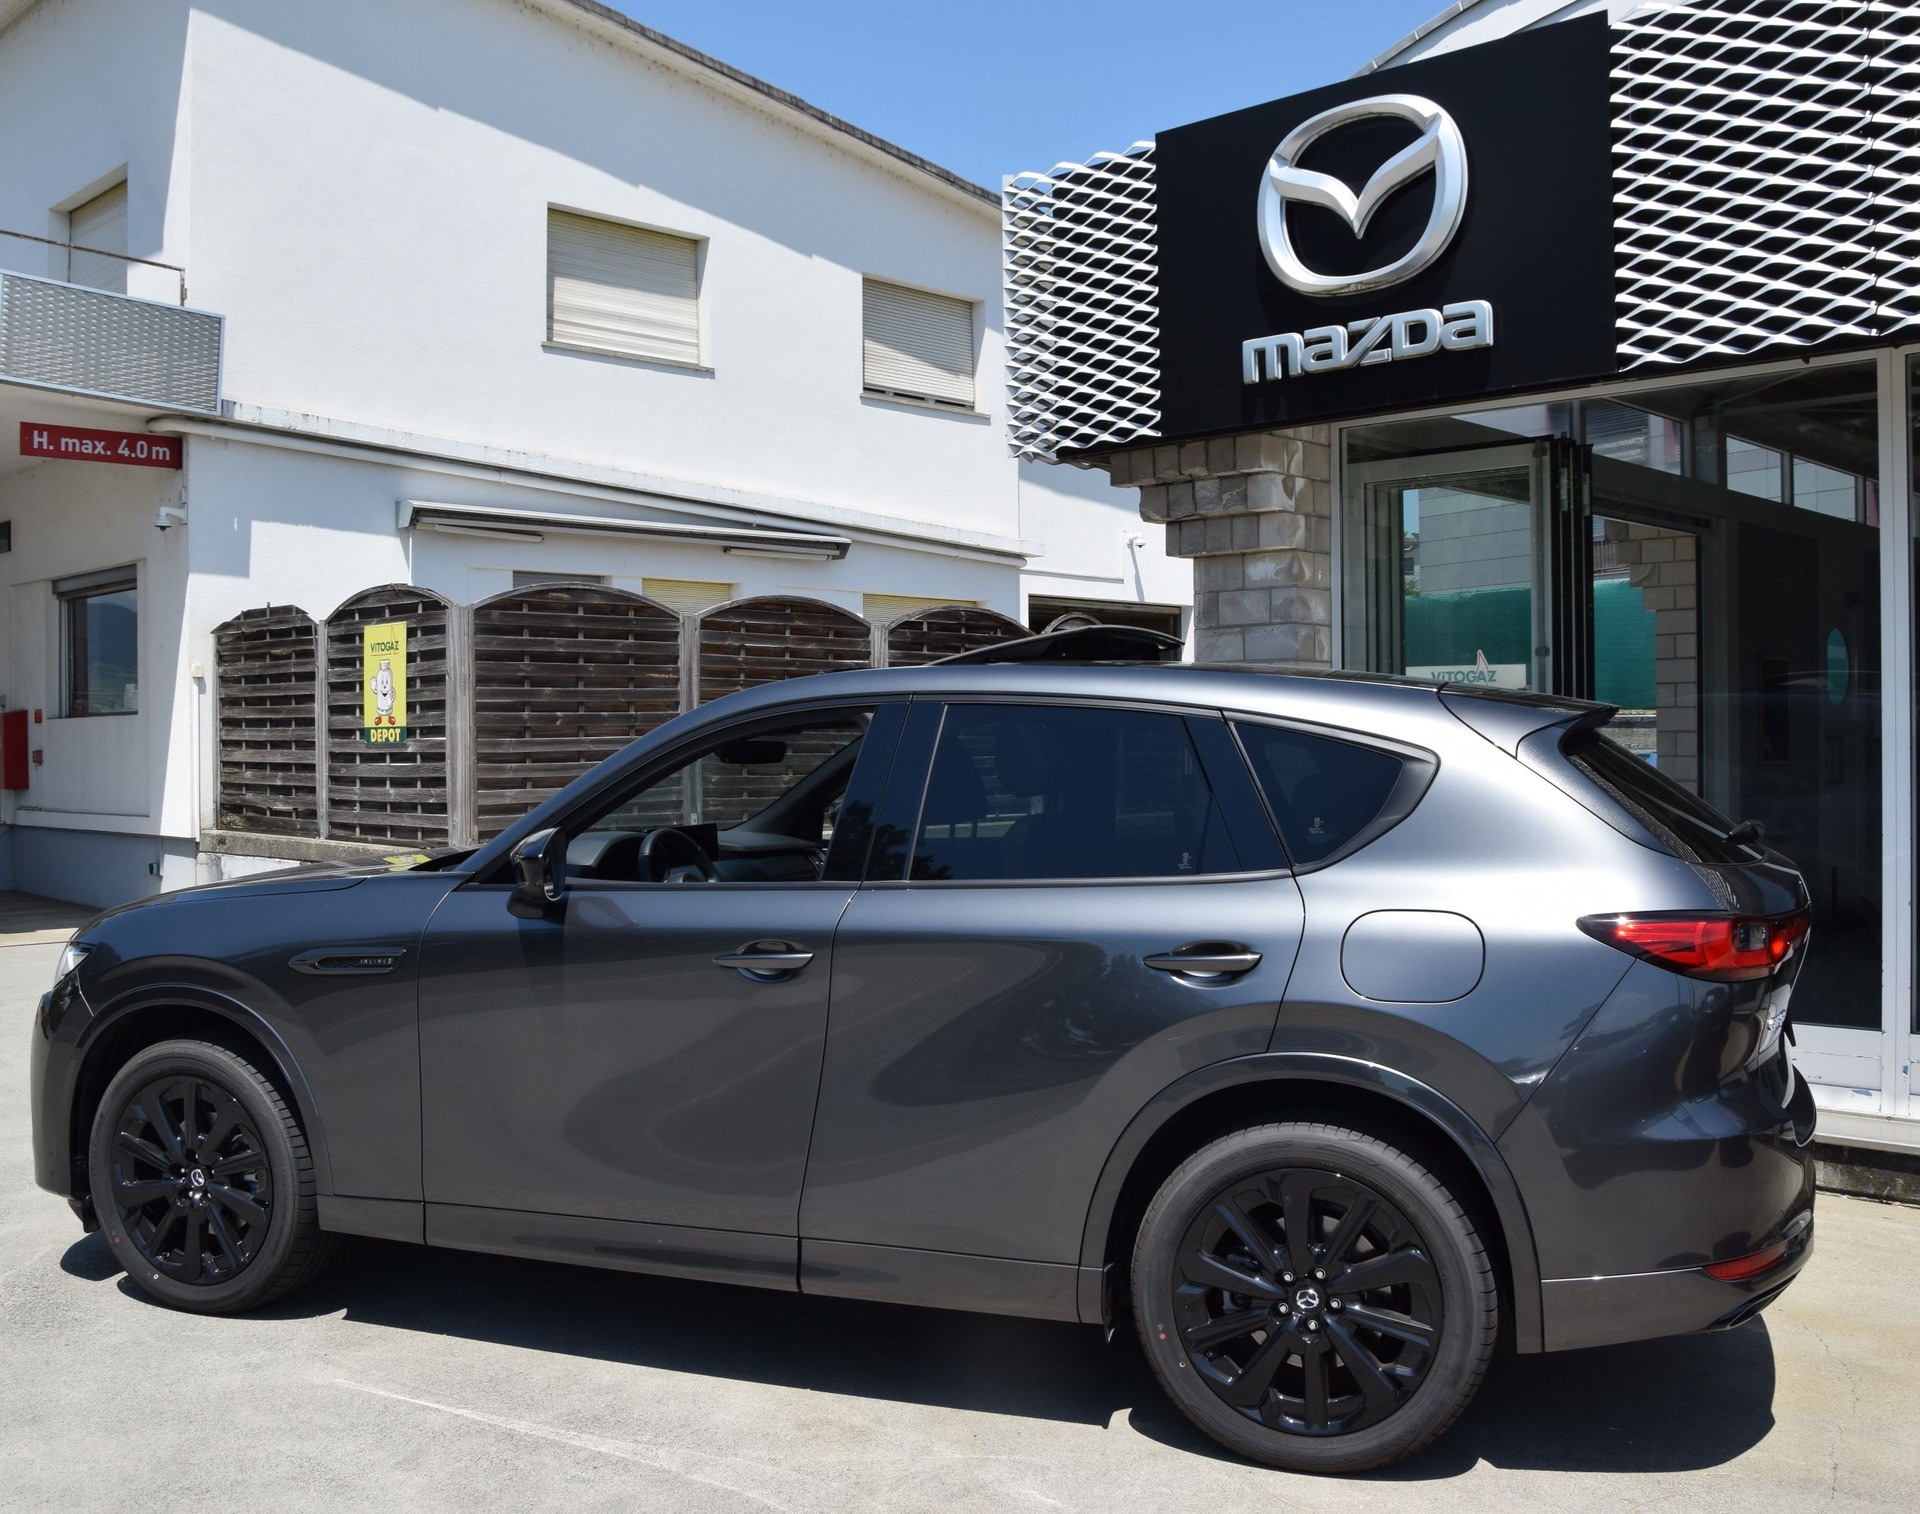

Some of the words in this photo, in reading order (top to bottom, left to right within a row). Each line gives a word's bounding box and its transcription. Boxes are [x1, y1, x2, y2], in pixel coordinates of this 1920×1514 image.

[33, 430, 54, 450] H.
[60, 437, 112, 455] max.
[117, 439, 148, 459] 4.0
[370, 728, 401, 743] DEPOT
